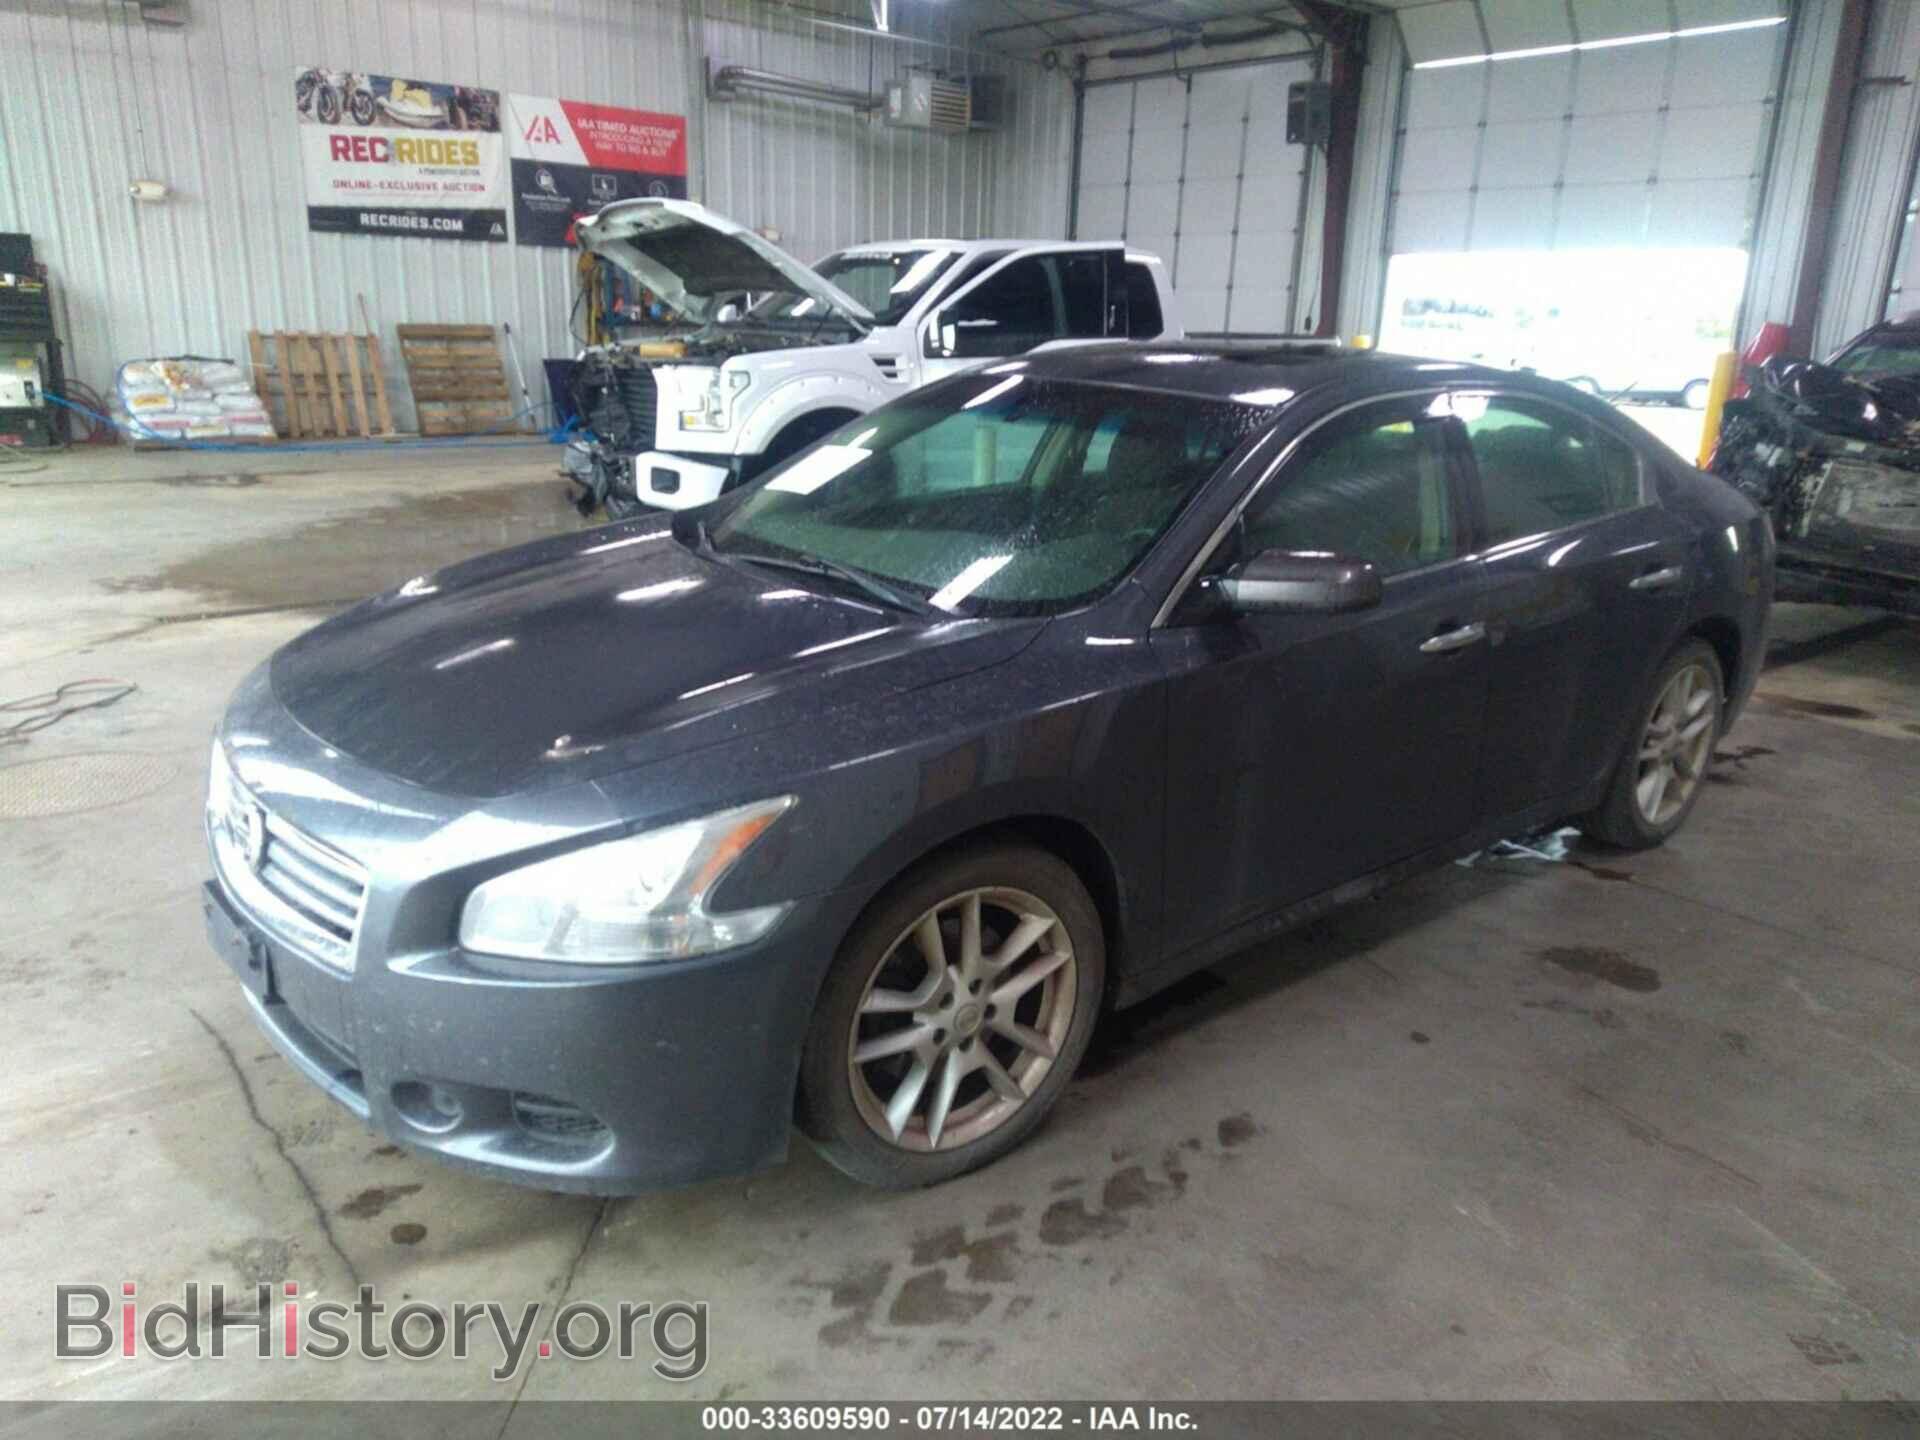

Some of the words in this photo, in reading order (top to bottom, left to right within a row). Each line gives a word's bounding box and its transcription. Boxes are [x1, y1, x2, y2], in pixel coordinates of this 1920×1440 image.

[395, 136, 480, 166] RIDES
[442, 182, 486, 192] AUCTION
[360, 212, 463, 231] RECRIDES.COM
